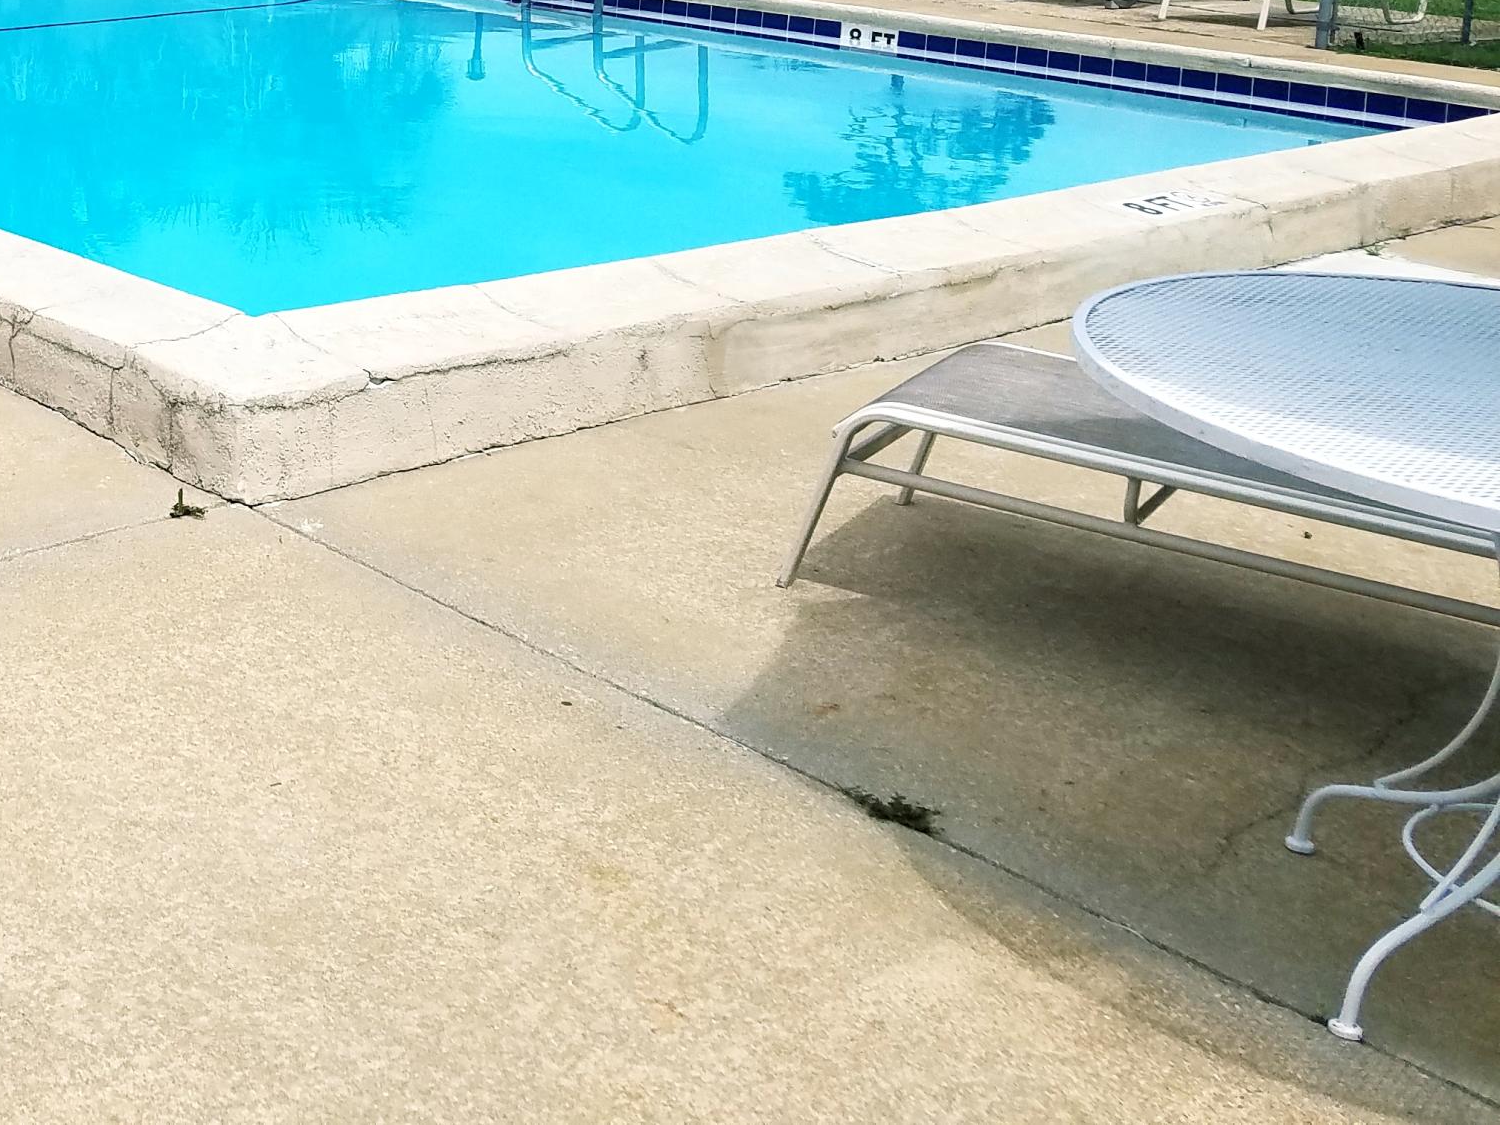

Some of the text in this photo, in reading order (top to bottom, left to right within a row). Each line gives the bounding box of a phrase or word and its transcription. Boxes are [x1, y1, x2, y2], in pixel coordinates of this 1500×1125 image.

[871, 31, 896, 46] FT
[1122, 195, 1196, 215] 8 FT
